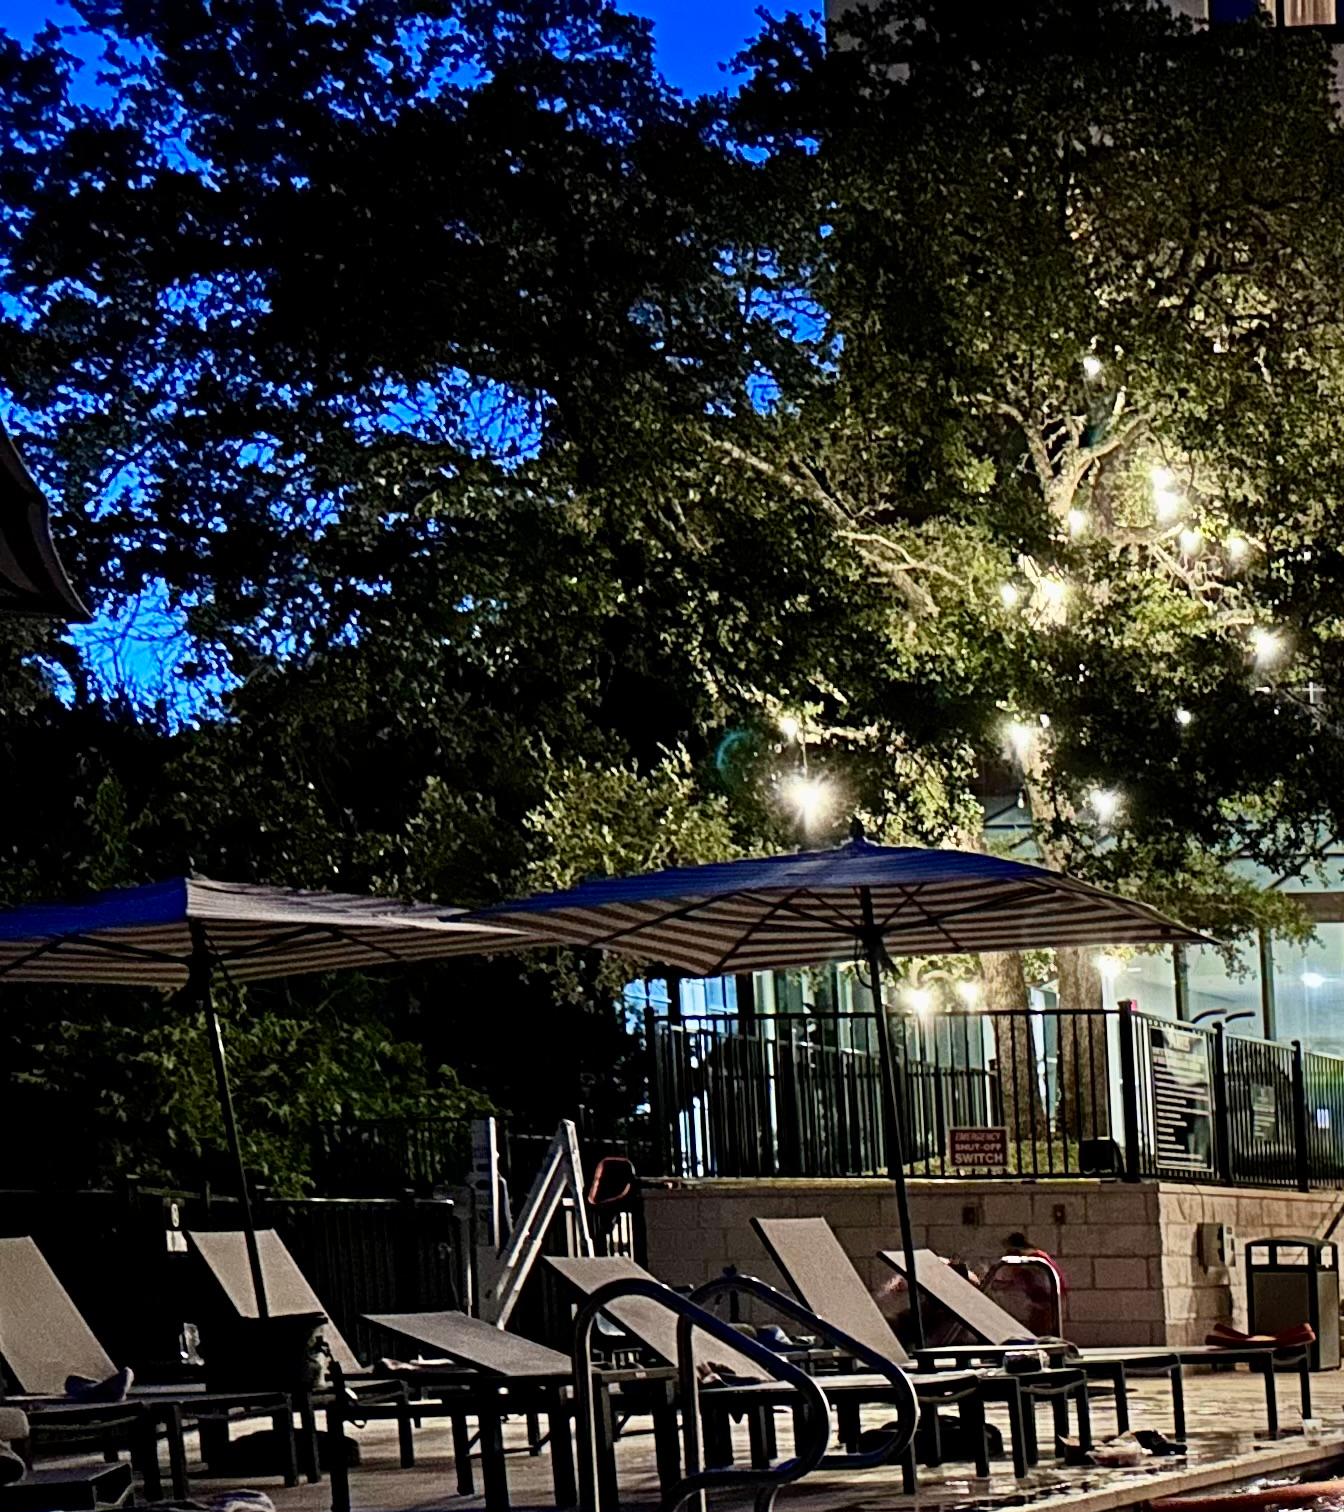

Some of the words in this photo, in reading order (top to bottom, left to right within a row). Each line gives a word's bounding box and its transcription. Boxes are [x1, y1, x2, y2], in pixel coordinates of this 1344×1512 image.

[955, 1132, 1001, 1141] EMERGENCY
[955, 1143, 1002, 1151] SHUT-OFF
[955, 1152, 1003, 1164] SWITCH
